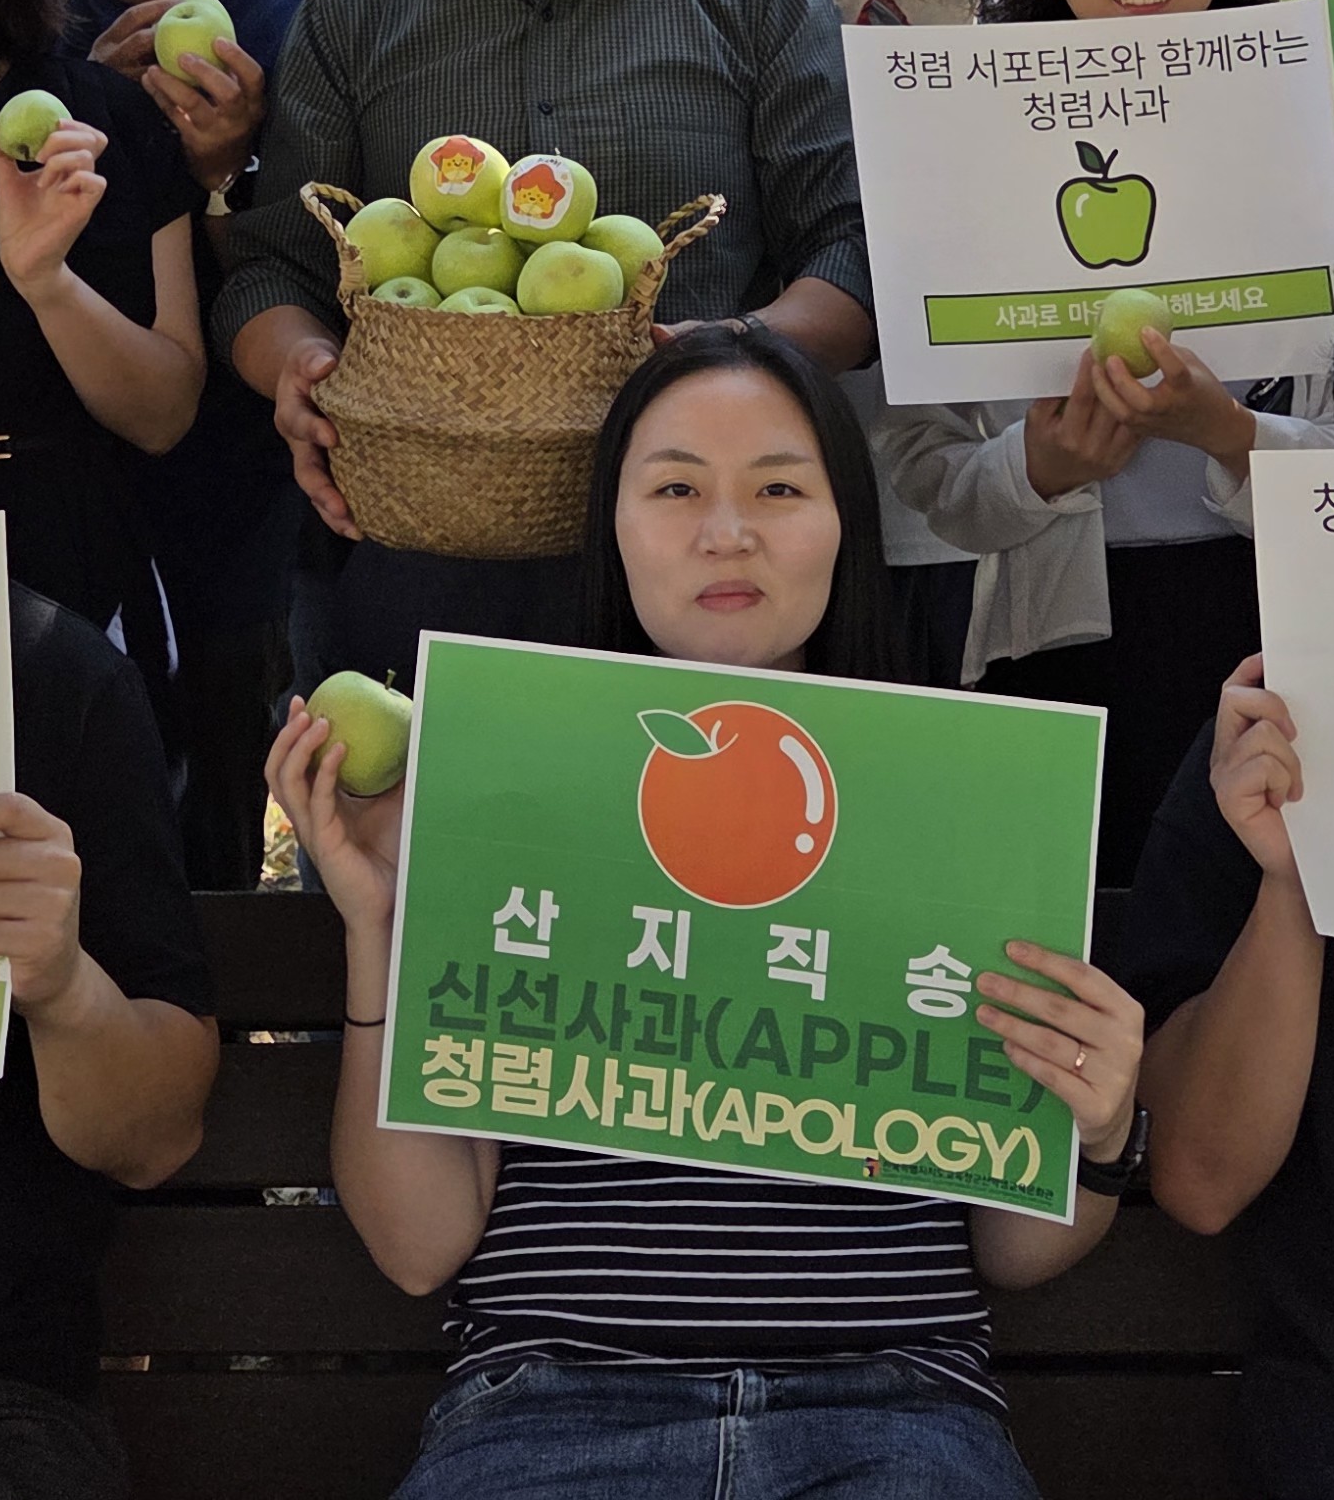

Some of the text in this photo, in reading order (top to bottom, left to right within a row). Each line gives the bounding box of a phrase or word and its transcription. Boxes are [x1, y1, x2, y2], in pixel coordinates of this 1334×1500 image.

[886, 30, 1309, 90] 청렴 서포터즈와 함께하는
[1023, 86, 1170, 131] 청렴사과
[995, 304, 1061, 330] 사과로
[1157, 286, 1268, 317] 해보세요
[493, 886, 973, 1018] 산 지 직 송
[421, 1034, 1042, 1187] 청렴사과(APOLOGY)
